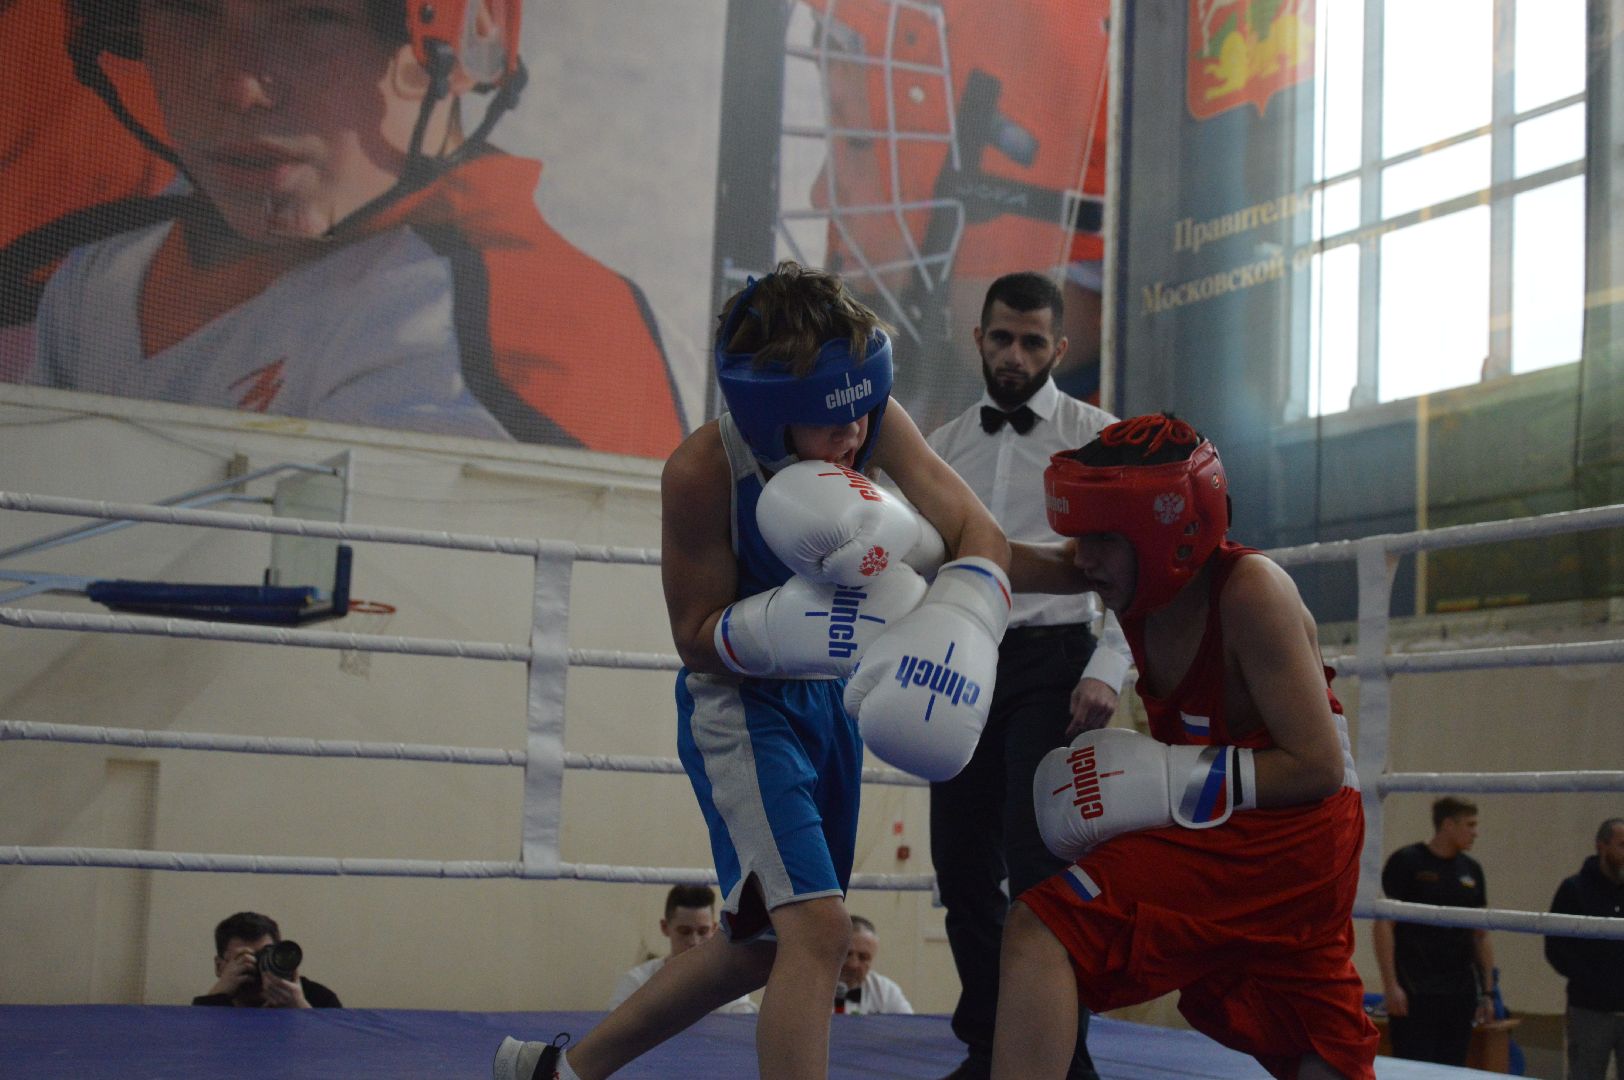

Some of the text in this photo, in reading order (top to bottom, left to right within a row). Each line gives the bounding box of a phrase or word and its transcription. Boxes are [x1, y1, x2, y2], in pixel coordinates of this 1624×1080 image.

[1140, 250, 1285, 315] Московской
[825, 378, 872, 410] clinch
[824, 460, 883, 503] clin
[895, 655, 980, 706] clinch
[1066, 745, 1104, 820] clinch
